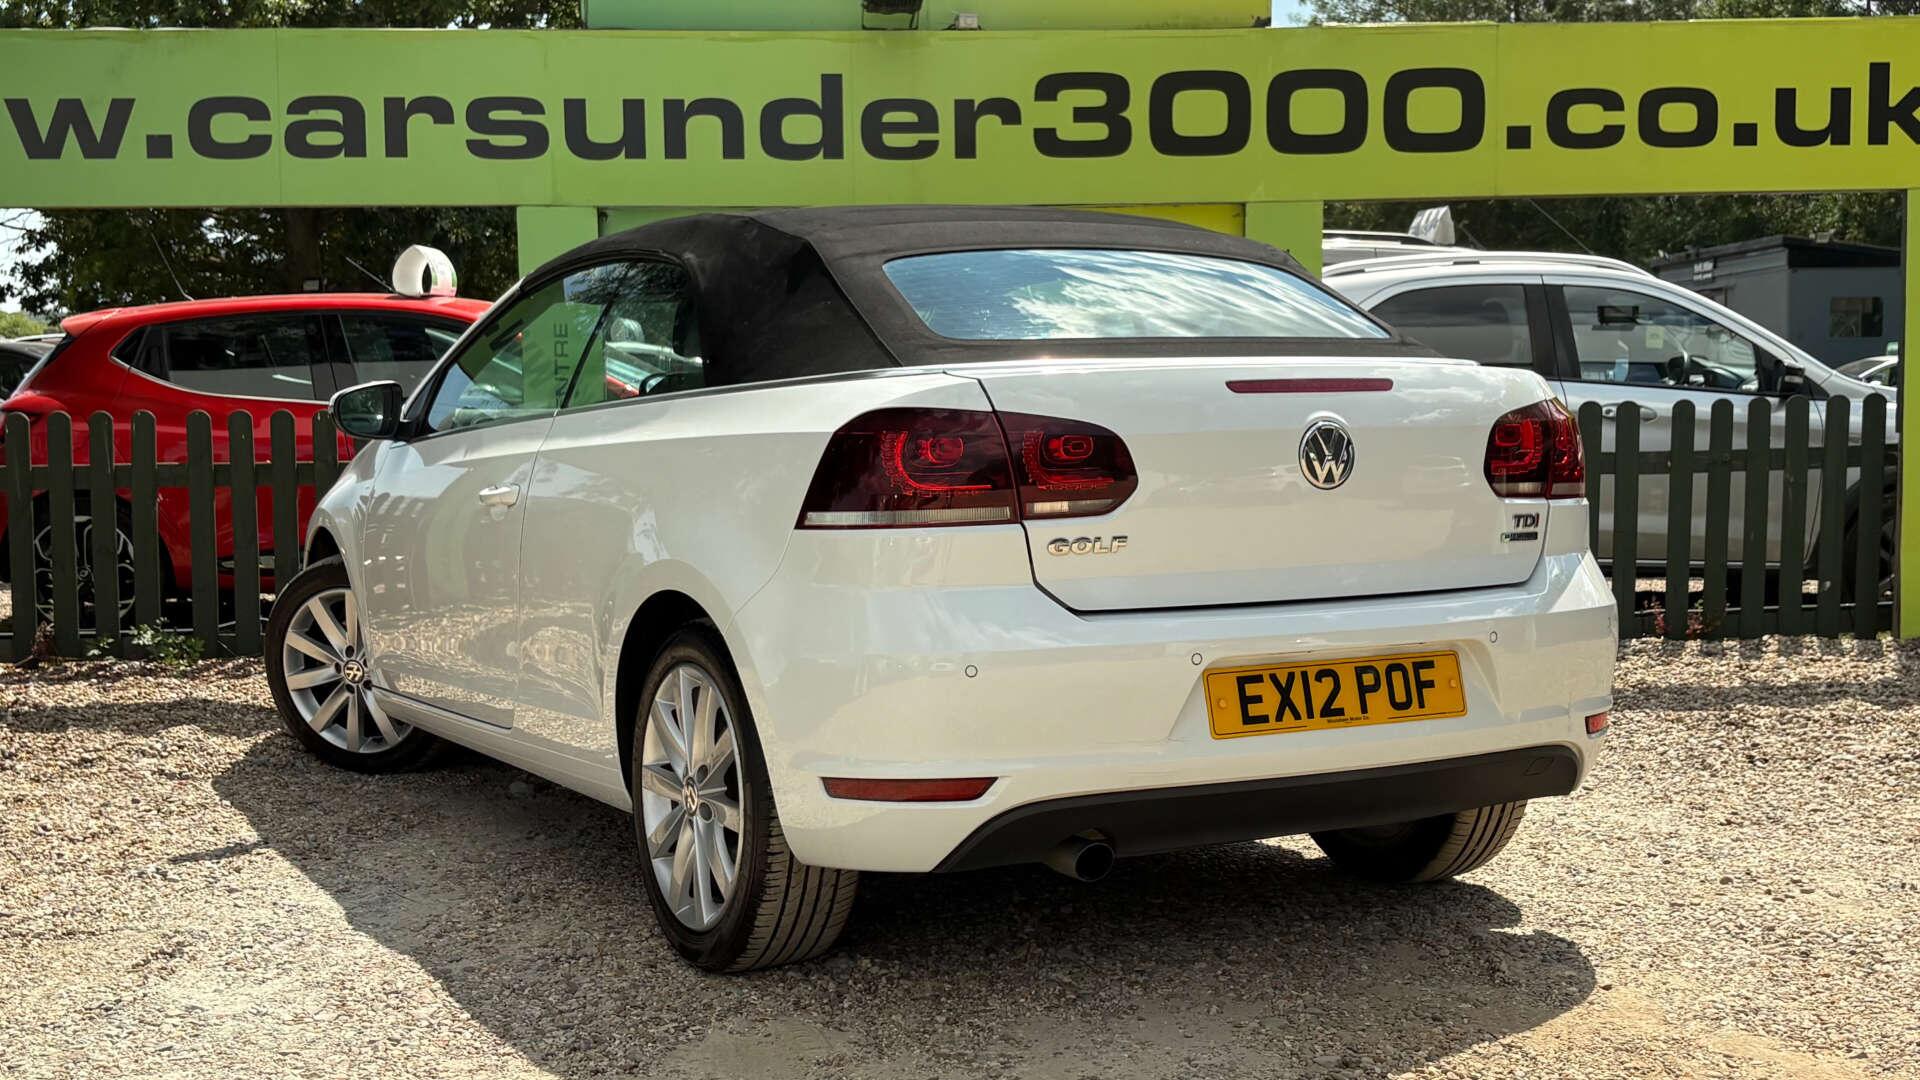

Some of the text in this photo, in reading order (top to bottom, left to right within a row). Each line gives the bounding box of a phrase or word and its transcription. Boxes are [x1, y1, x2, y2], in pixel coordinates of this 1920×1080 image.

[4, 62, 1920, 160] w.carsunder3000.co.uk
[553, 323, 569, 409] NTRE
[1047, 535, 1128, 555] GOLF
[1513, 513, 1539, 528] TDI
[1236, 660, 1436, 725] EX12 POF
